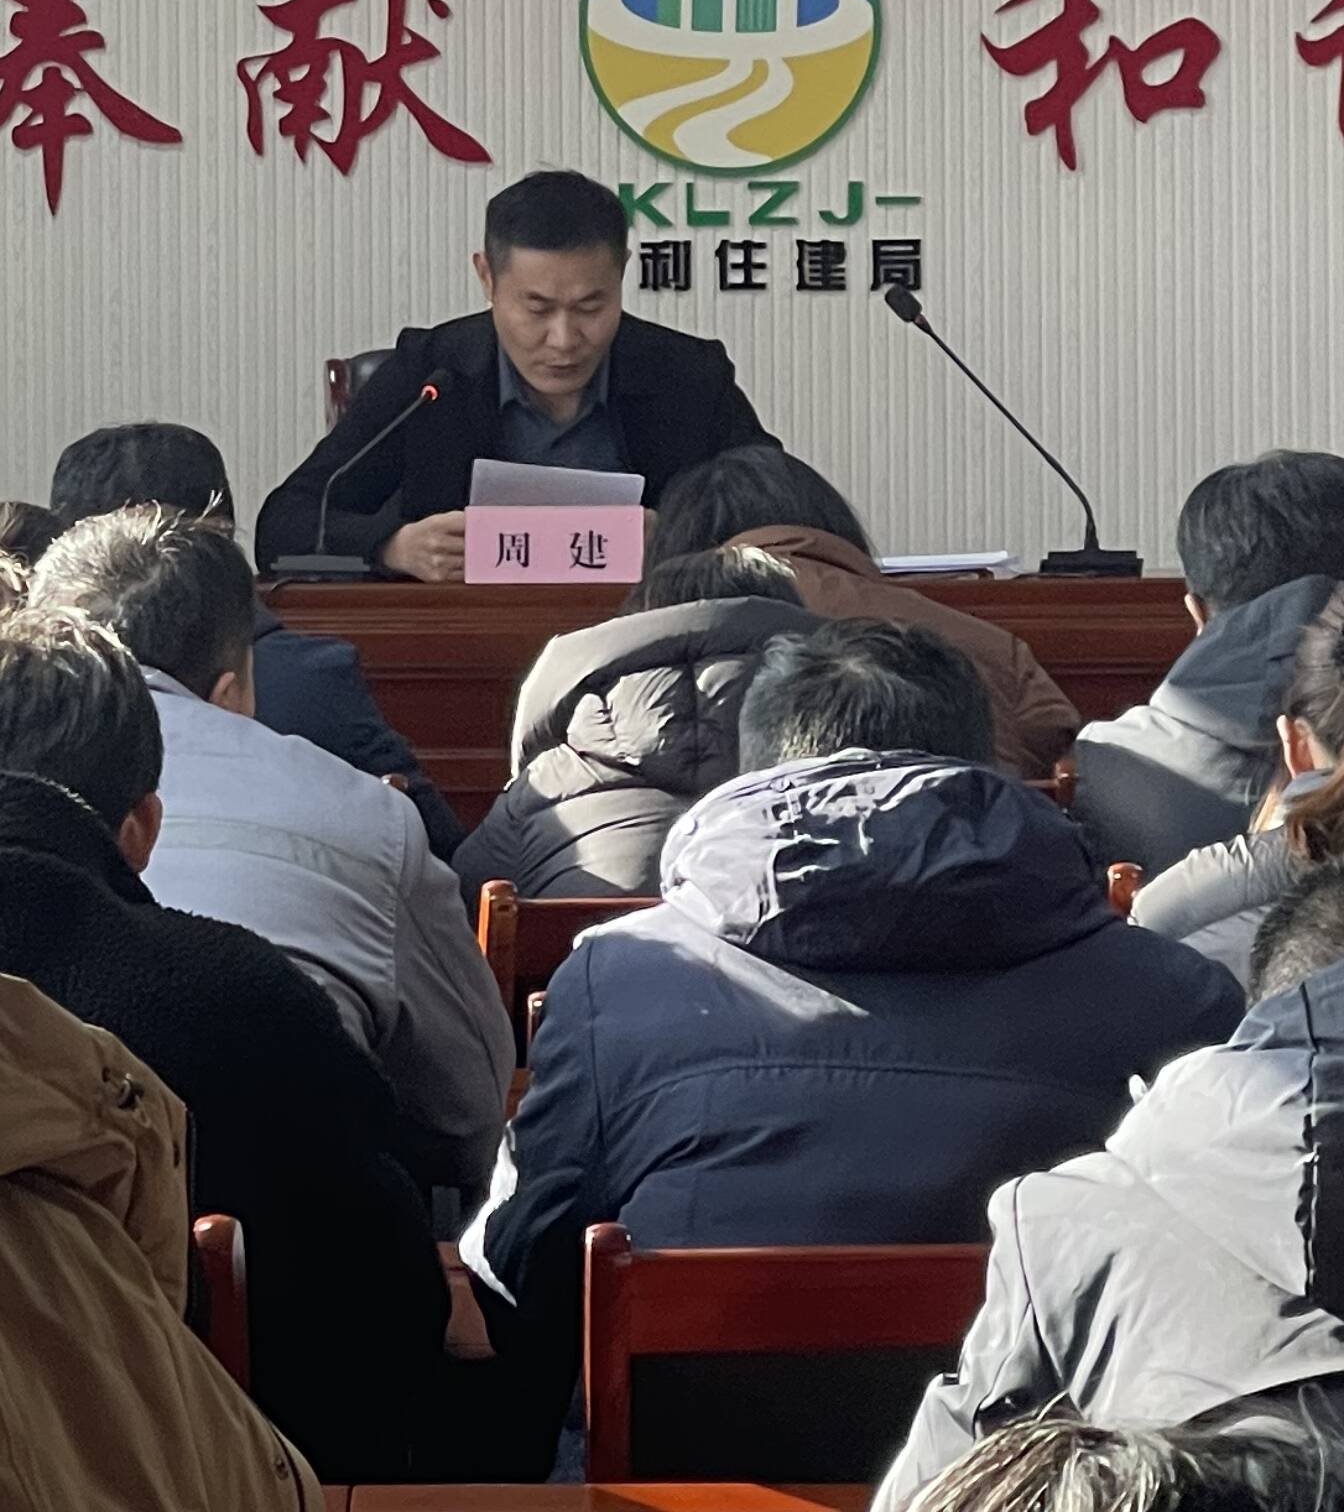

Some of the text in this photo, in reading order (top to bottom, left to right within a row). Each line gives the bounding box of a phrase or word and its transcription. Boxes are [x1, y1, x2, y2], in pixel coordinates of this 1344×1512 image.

[639, 238, 922, 292] 利住建局
[494, 529, 609, 570] 周建
